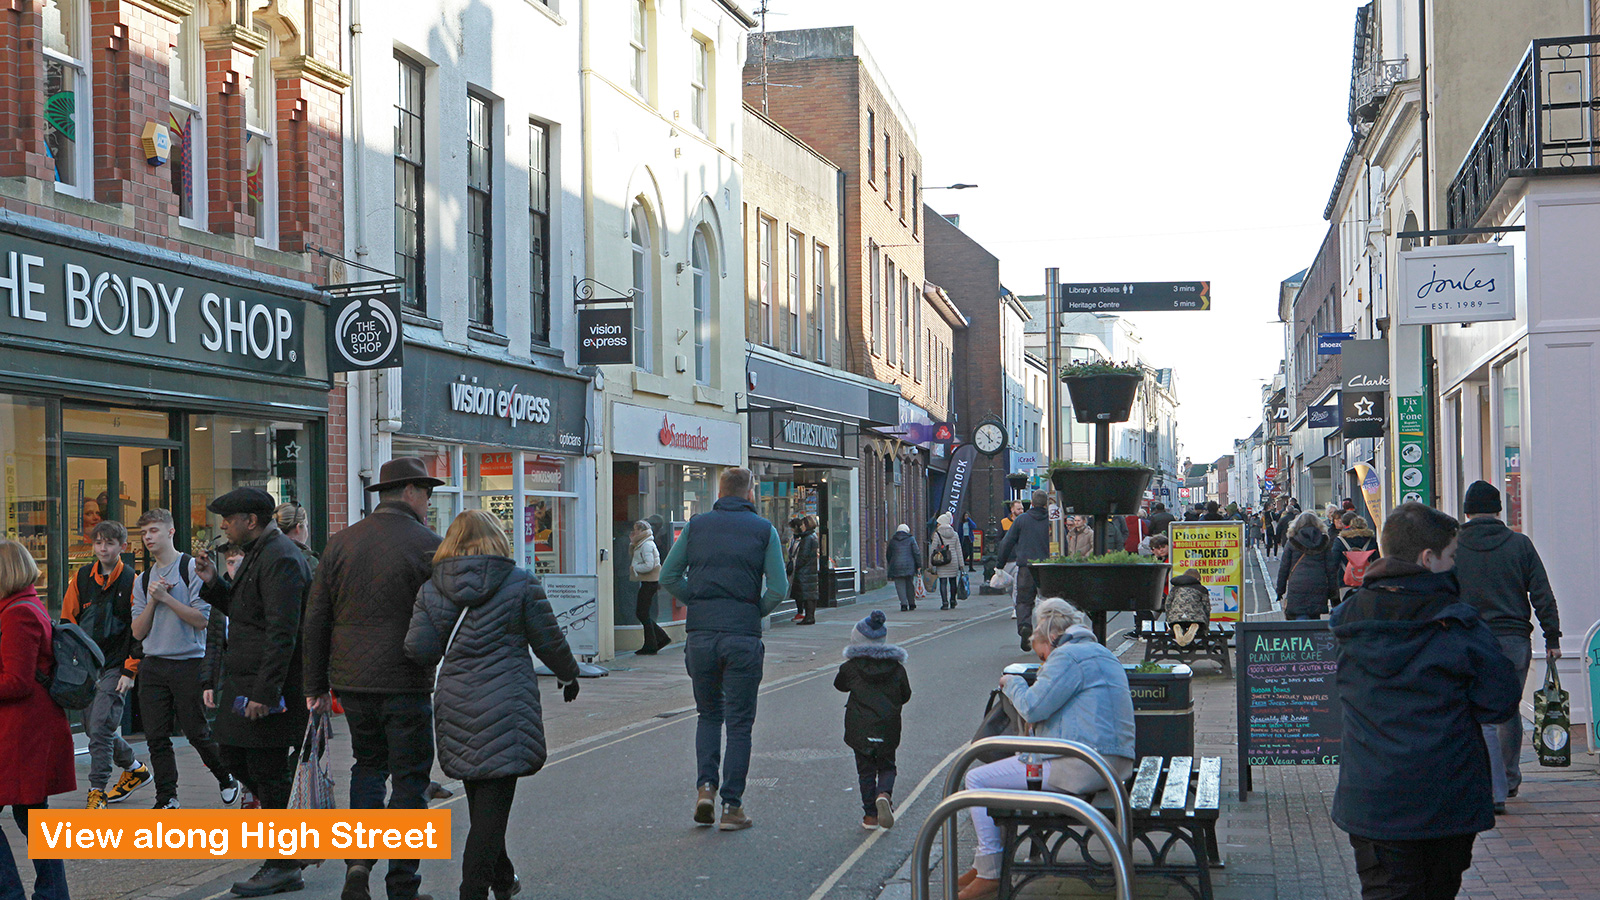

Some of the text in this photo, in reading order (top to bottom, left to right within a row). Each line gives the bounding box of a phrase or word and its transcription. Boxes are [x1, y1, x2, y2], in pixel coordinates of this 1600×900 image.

[1417, 264, 1496, 299] joules
[1068, 287, 1091, 295] Library
[0, 251, 293, 361] HE BODY SHOP
[1068, 301, 1096, 309] Heritage
[1431, 300, 1483, 310] EST. 1989
[356, 320, 376, 332] THE
[589, 323, 622, 335] vision
[350, 330, 382, 344] BODY
[583, 336, 628, 349] express
[352, 341, 382, 354] SHOP
[1348, 375, 1390, 387] Clarks
[450, 374, 550, 428] vision express
[1403, 397, 1418, 405] Fix
[1273, 407, 1290, 419] JD
[1400, 412, 1422, 420] Fone
[559, 432, 582, 447] opticians
[670, 423, 709, 451] Santander
[783, 419, 838, 450] WATERSTONES
[871, 438, 903, 462] W
[947, 459, 968, 513] SALTROCK
[1175, 530, 1237, 540] Phone Bits
[1184, 548, 1228, 559] CRACKED
[1202, 575, 1215, 583] YOU
[1254, 634, 1314, 652] ALEAFIA
[1249, 652, 1276, 663] PLANT
[1280, 652, 1297, 661] BAR
[1266, 665, 1287, 673] VEGAN
[1298, 664, 1322, 672] GLUTEN
[1130, 687, 1165, 698] ouncil
[1248, 756, 1268, 765] 100%
[1271, 756, 1297, 765] Vegan
[1301, 757, 1317, 765] and
